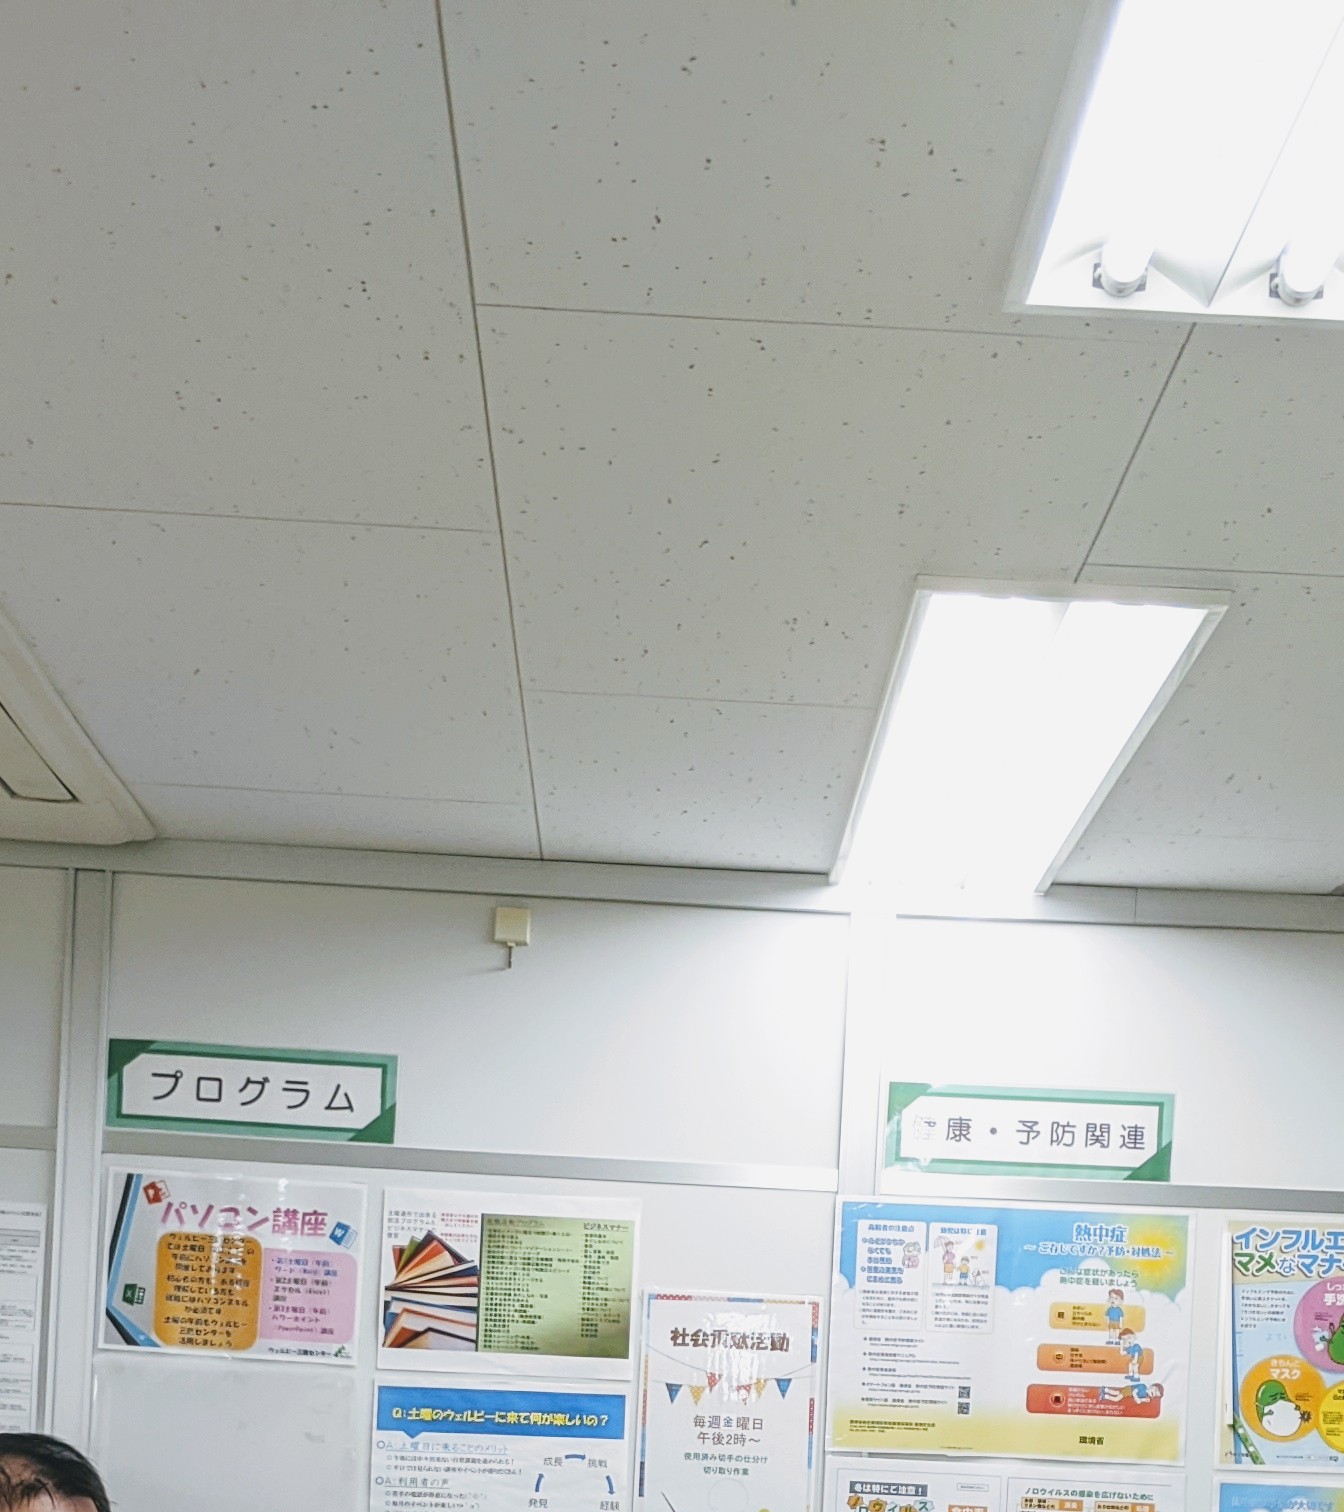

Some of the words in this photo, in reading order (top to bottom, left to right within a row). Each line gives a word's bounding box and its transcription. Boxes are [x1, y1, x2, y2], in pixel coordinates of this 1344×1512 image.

[151, 1069, 355, 1113] プログラム
[160, 1200, 329, 1238] パソコン講座
[1074, 1223, 1128, 1245] 熱中症
[1269, 1368, 1301, 1381] マスク
[693, 1414, 765, 1431] 毎週金曜日
[1079, 1435, 1105, 1446] 環境省
[543, 1456, 563, 1467] 成長
[683, 1452, 769, 1465] 使用済み切手の仕分け
[702, 1465, 751, 1477] 切り取り作業
[1025, 1487, 1154, 1501] ノロウイルスの感染を広げないために
[528, 1498, 549, 1509] 発見
[599, 1500, 621, 1512] 経験
